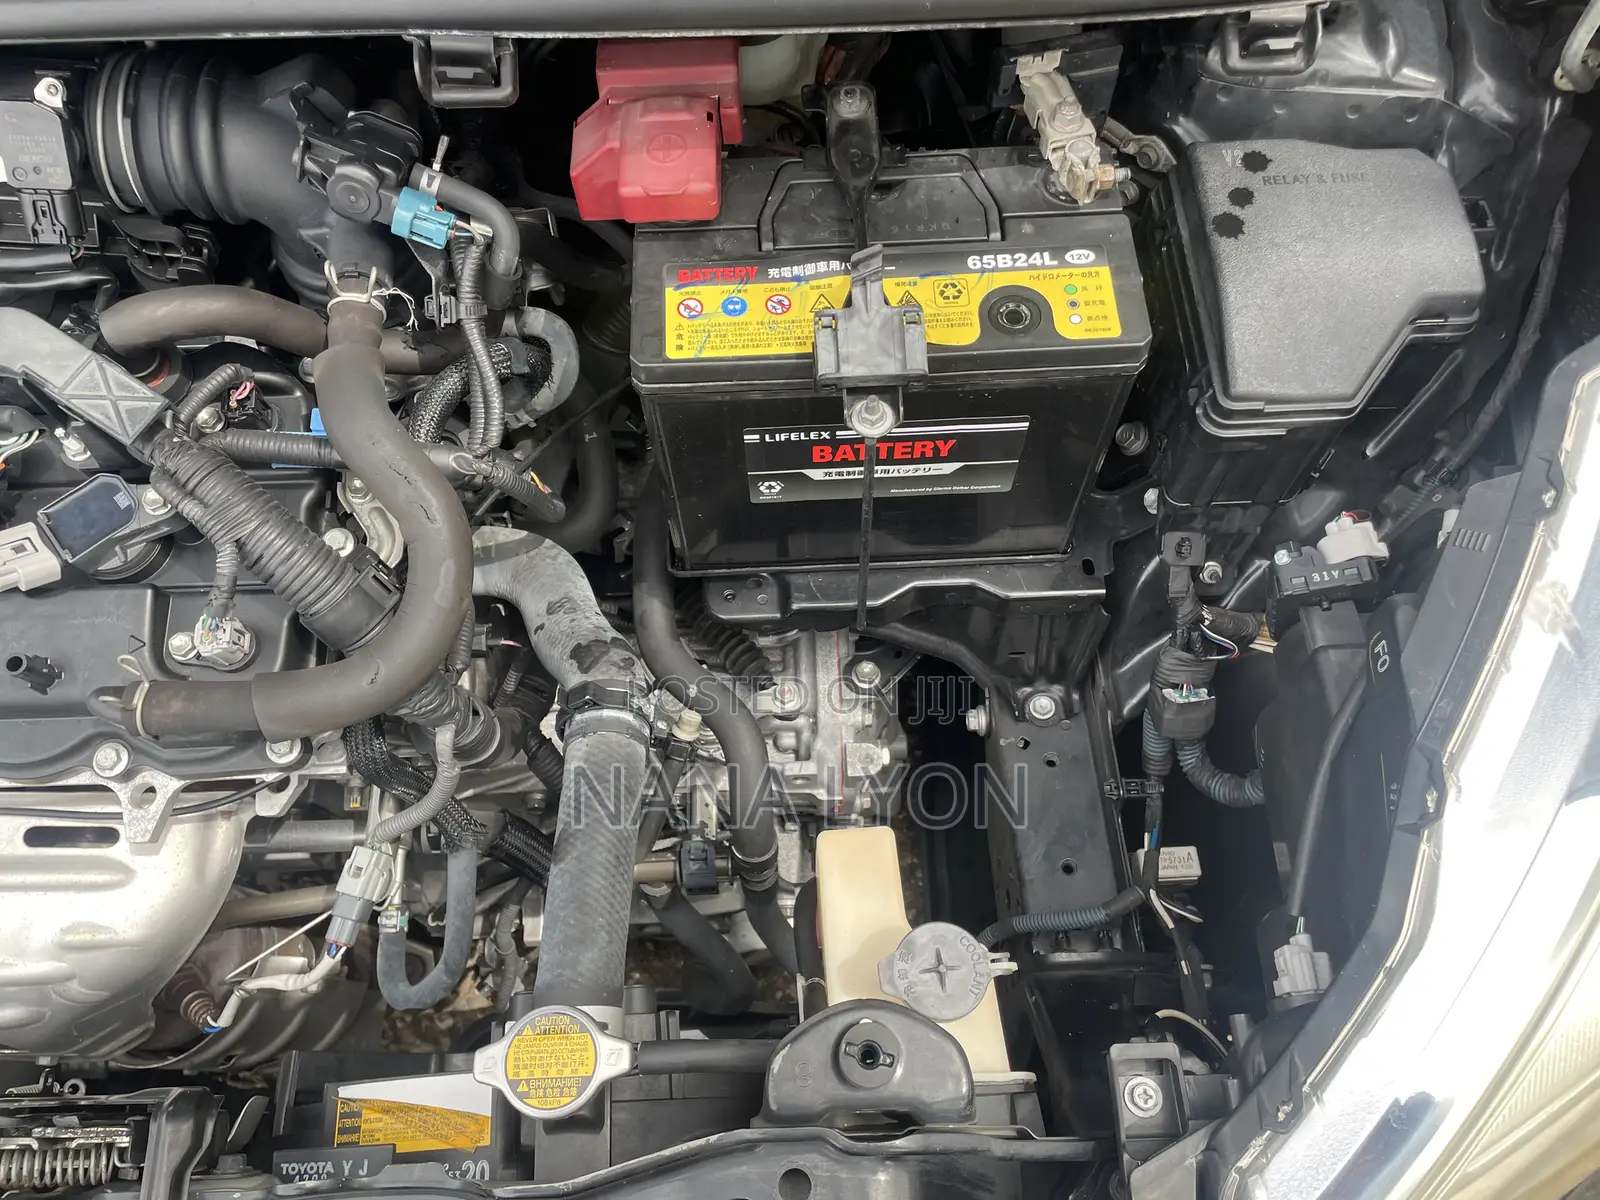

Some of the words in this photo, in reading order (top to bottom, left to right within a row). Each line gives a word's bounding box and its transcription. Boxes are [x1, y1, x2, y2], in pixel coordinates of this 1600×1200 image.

[1261, 174, 1311, 186] RELAY
[1317, 174, 1327, 184] &
[967, 251, 1059, 270] 65B24L
[1068, 252, 1090, 261] 12V
[677, 265, 759, 283] BATTERY
[1028, 271, 1100, 281] ハイドロメーターの見方
[765, 430, 831, 442] LIFELEX
[812, 439, 957, 463] BATTERY
[959, 935, 986, 1001] COOLANT
[535, 1015, 570, 1026] CAUTION
[534, 1024, 580, 1035] ATTENTION
[529, 1077, 582, 1089] ВНИМАНИЕ!
[338, 1117, 361, 1128] ATTENTION
[280, 1160, 335, 1175] TOYOTA
